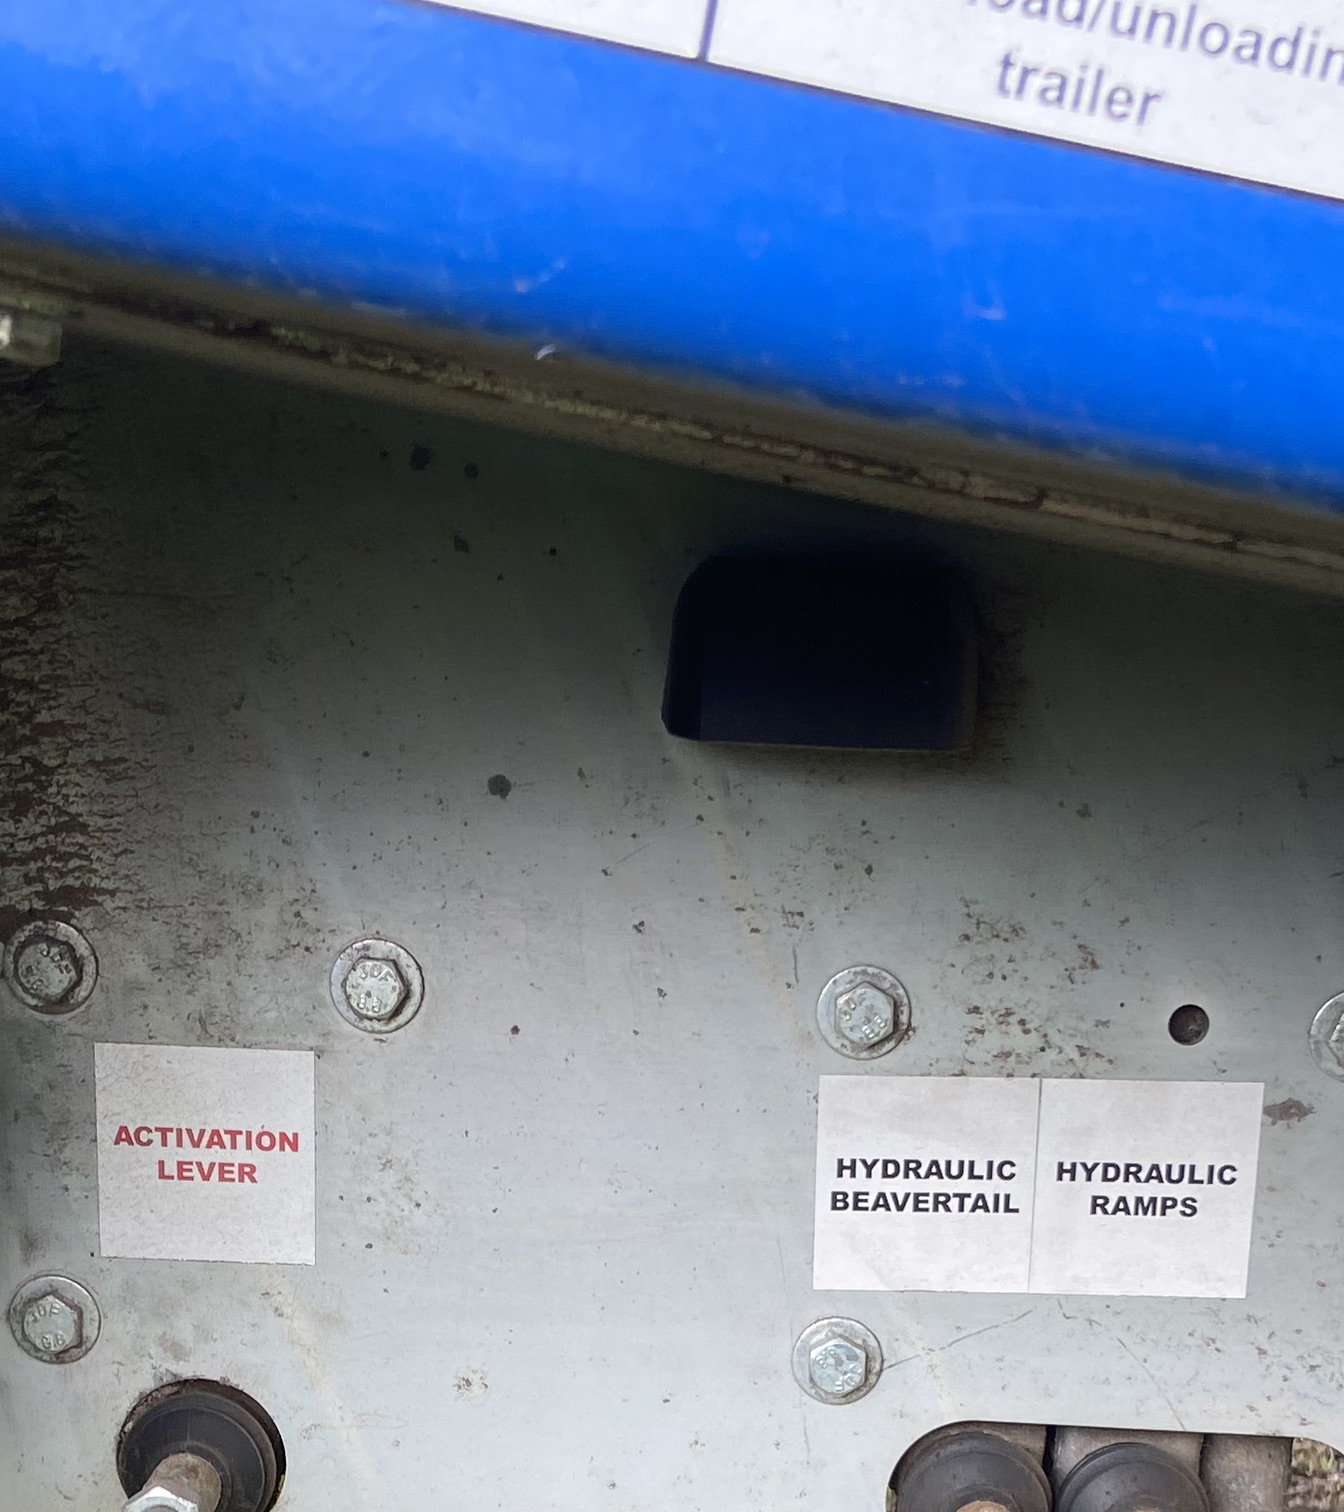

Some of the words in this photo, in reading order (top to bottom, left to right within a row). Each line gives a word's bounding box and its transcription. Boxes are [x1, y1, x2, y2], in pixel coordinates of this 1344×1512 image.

[997, 51, 1162, 126] trailer
[113, 1125, 299, 1153] ACTIVATION
[157, 1159, 258, 1184] LEVER
[836, 1158, 1017, 1182] HYDRAULIC
[1056, 1161, 1238, 1186] HYDRAULIC
[830, 1191, 1020, 1215] BEAVERTAIL
[1089, 1195, 1198, 1218] RAMPS
